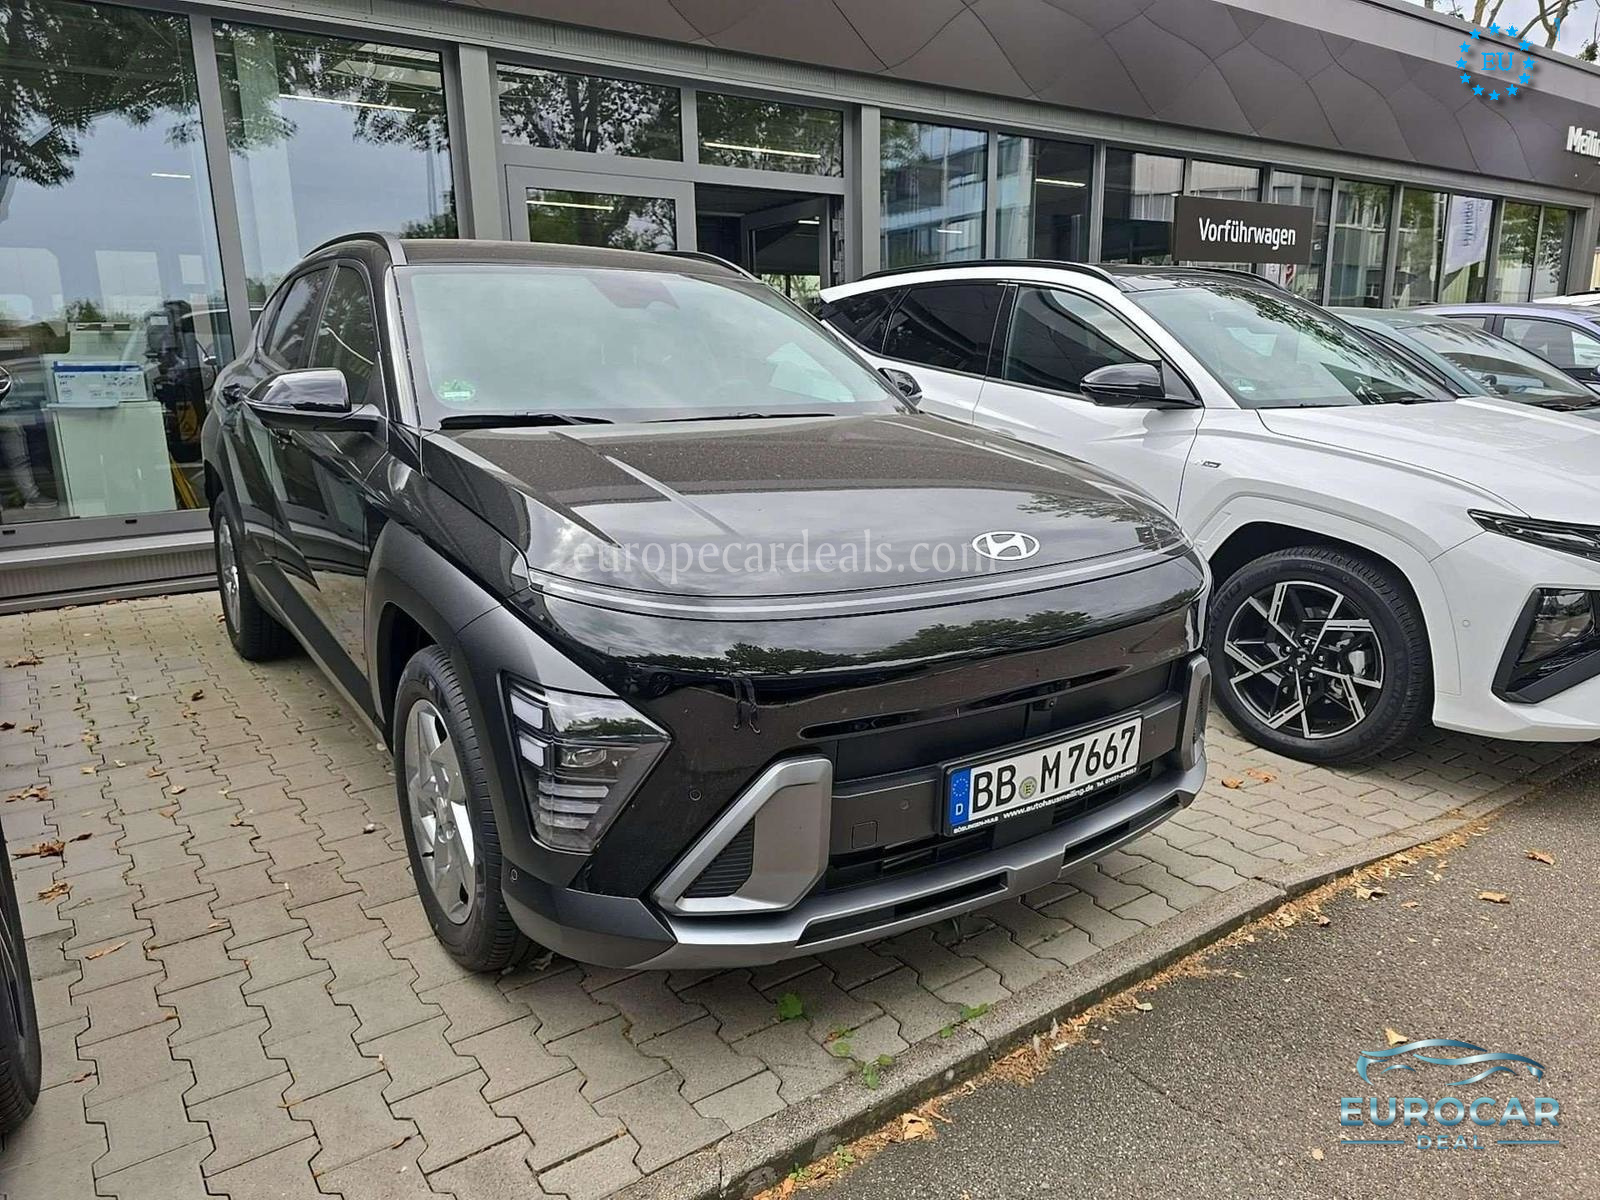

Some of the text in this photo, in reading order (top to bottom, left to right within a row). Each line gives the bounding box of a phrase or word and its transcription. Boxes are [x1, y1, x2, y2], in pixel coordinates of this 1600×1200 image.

[1198, 217, 1296, 251] Vorführwagen
[972, 725, 1137, 814] BB M 7667
[955, 803, 964, 816] D
